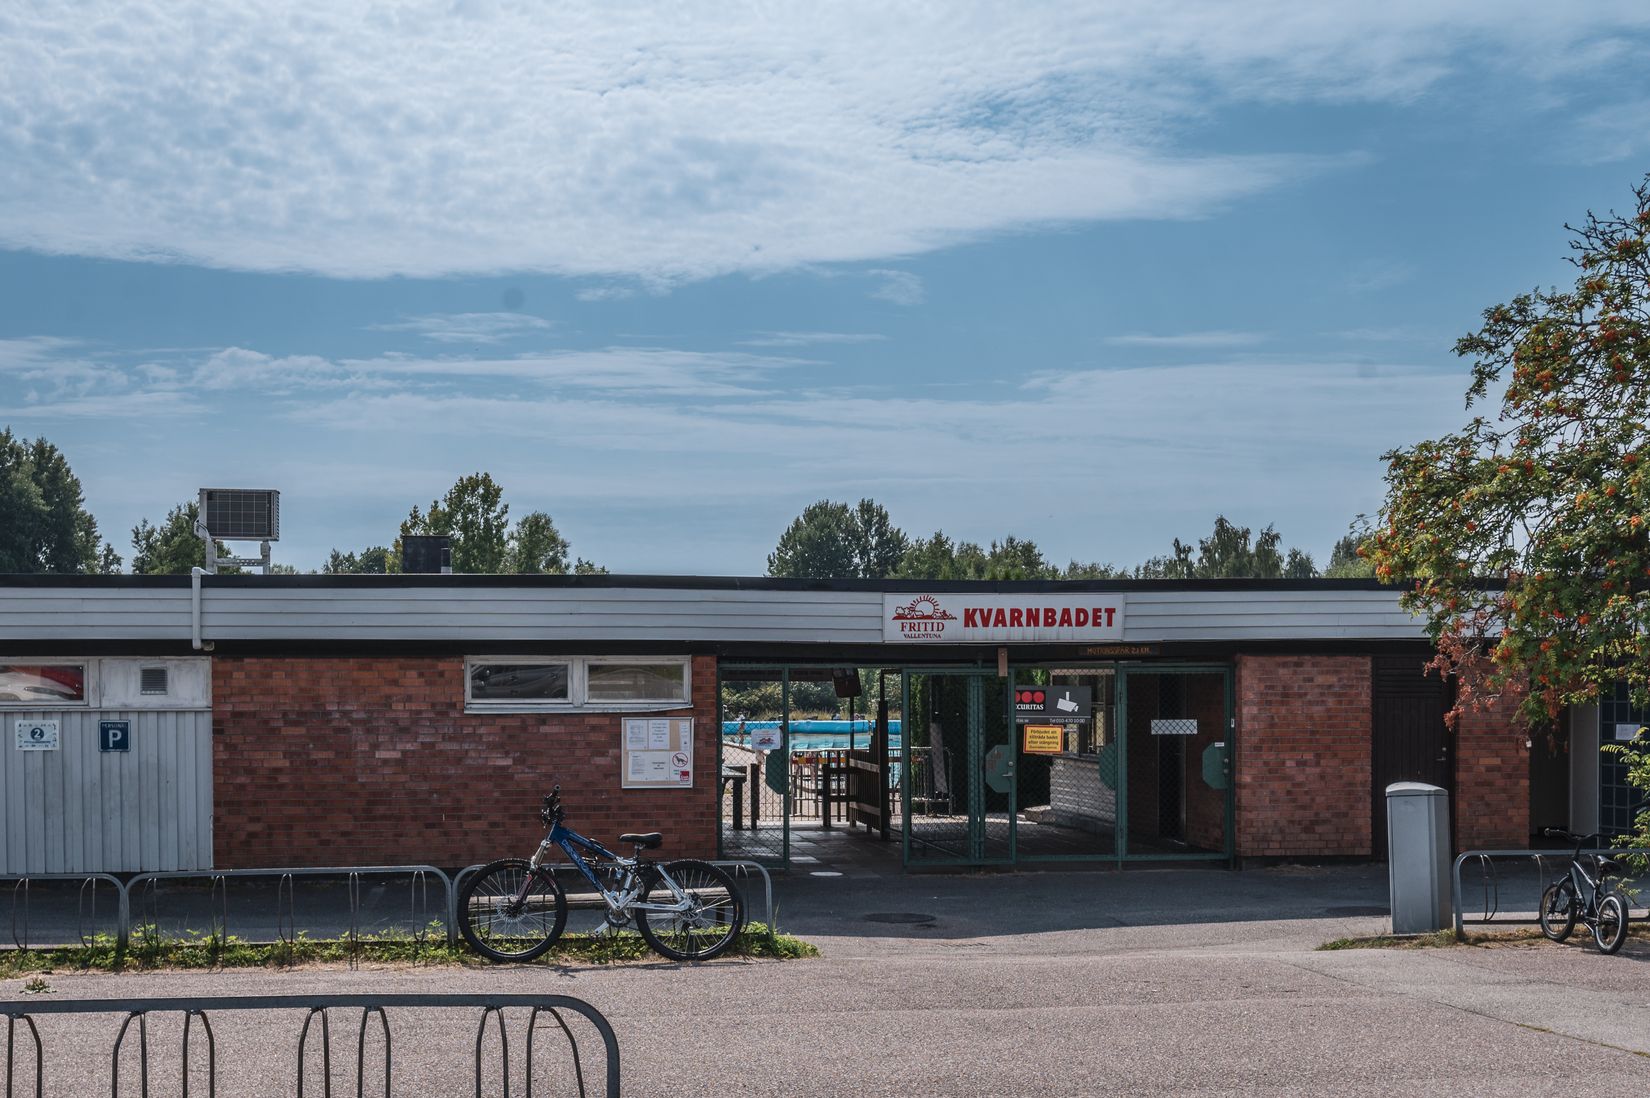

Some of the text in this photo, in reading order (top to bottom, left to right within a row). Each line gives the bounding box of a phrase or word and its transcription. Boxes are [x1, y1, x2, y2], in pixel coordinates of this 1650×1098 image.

[963, 607, 1117, 628] KVARNBADET
[900, 621, 945, 632] FRITID
[34, 728, 41, 738] 2
[108, 729, 122, 748] P
